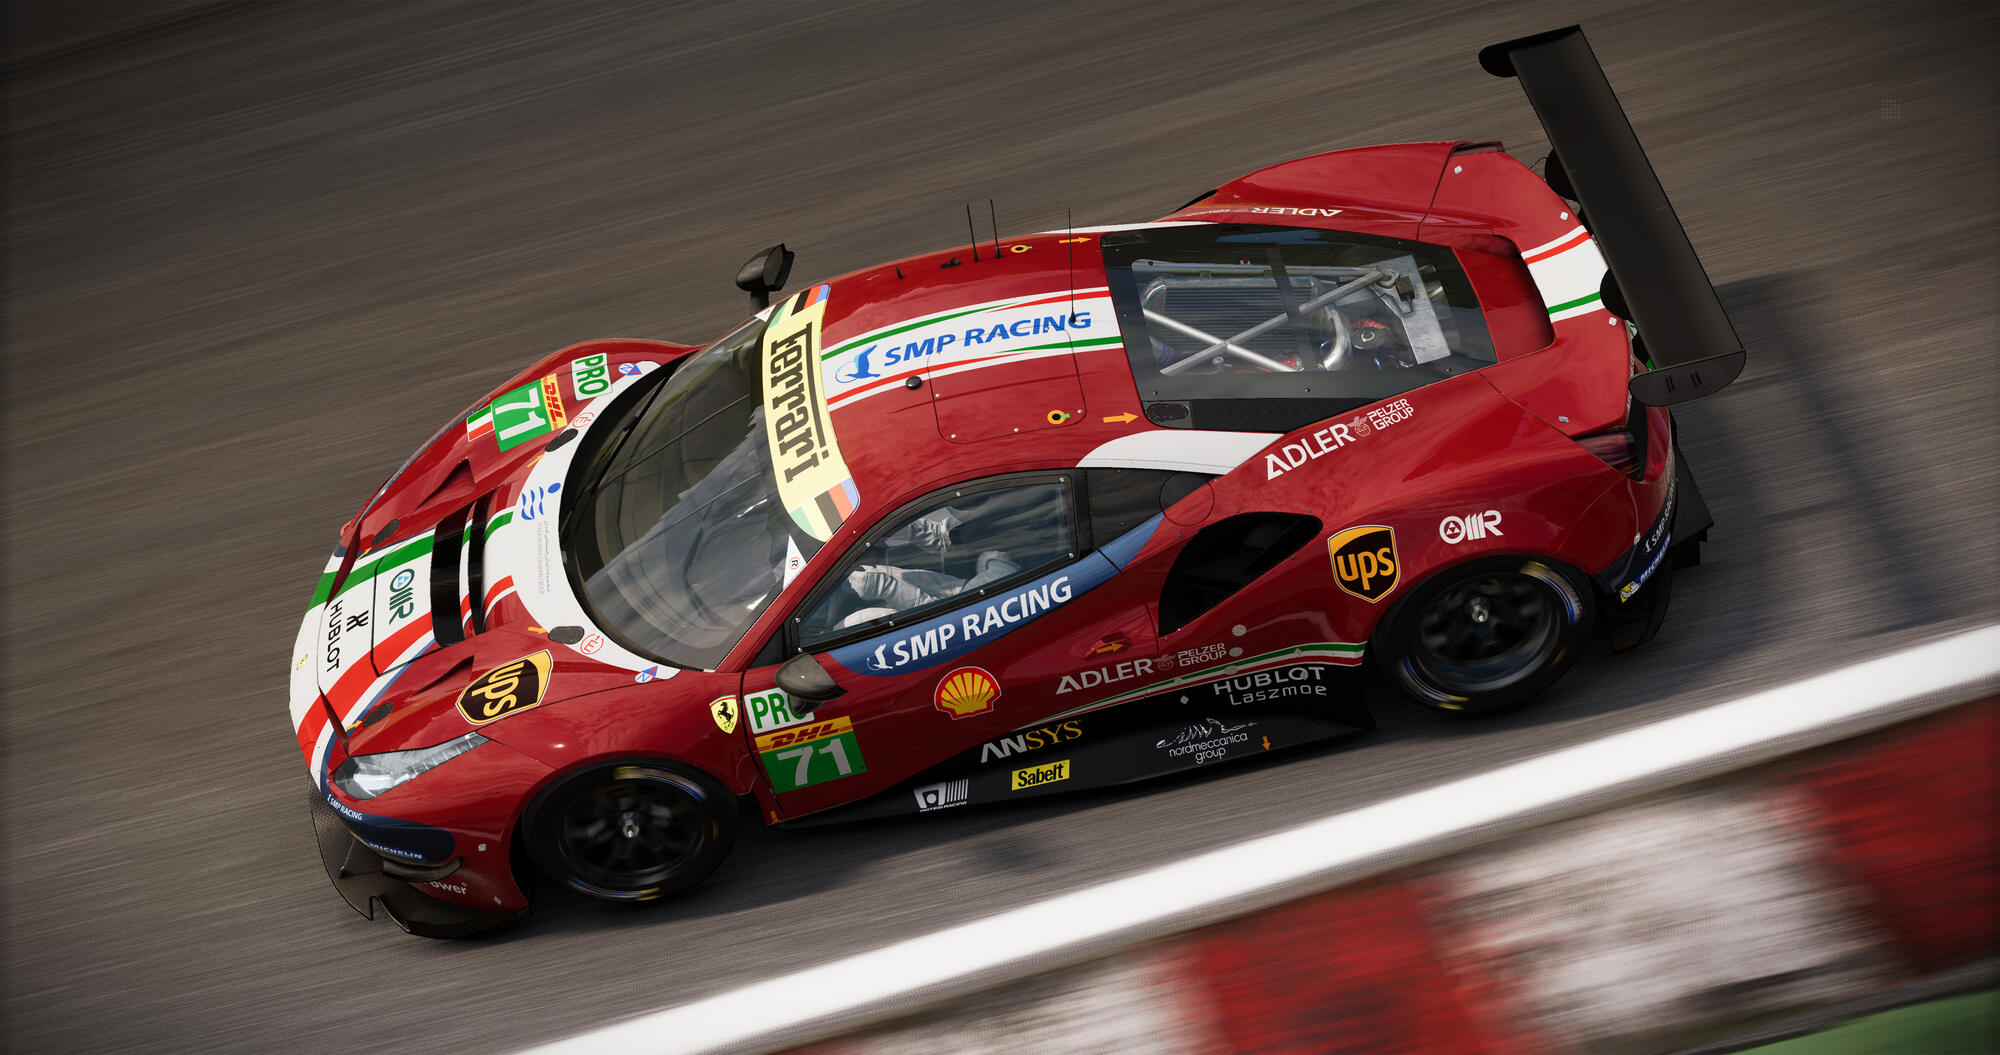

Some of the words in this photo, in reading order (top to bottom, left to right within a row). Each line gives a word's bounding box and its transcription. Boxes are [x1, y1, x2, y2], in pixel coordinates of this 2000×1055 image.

[1251, 207, 1344, 217] ADLER
[884, 334, 956, 366] SMP
[963, 312, 1092, 347] RACING
[575, 355, 609, 395] PRO
[495, 387, 547, 441] 71
[544, 382, 563, 424] DHL
[770, 322, 830, 483] Ferrari
[1366, 398, 1411, 422] PELZER
[1373, 407, 1415, 430] GROUP
[1264, 423, 1356, 481] ADLER
[1336, 547, 1396, 591] ups
[326, 600, 344, 673] HUBLOT
[892, 623, 956, 666] SMP
[962, 576, 1073, 641] RACING
[1177, 643, 1225, 660] PELZER
[1179, 650, 1227, 667] GROUP
[471, 662, 525, 717] ups
[1056, 658, 1155, 695] ADLER
[1213, 667, 1325, 695] HUBLOT
[770, 722, 840, 748] DHL
[980, 720, 1083, 764] ANSYS
[1169, 732, 1249, 757] nordmeccanica
[776, 738, 853, 787] 71
[1195, 748, 1227, 764] group
[1017, 763, 1065, 787] Sabelt
[340, 805, 363, 821] RACING
[369, 842, 423, 859] MICHELIN
[423, 881, 468, 895] ower
